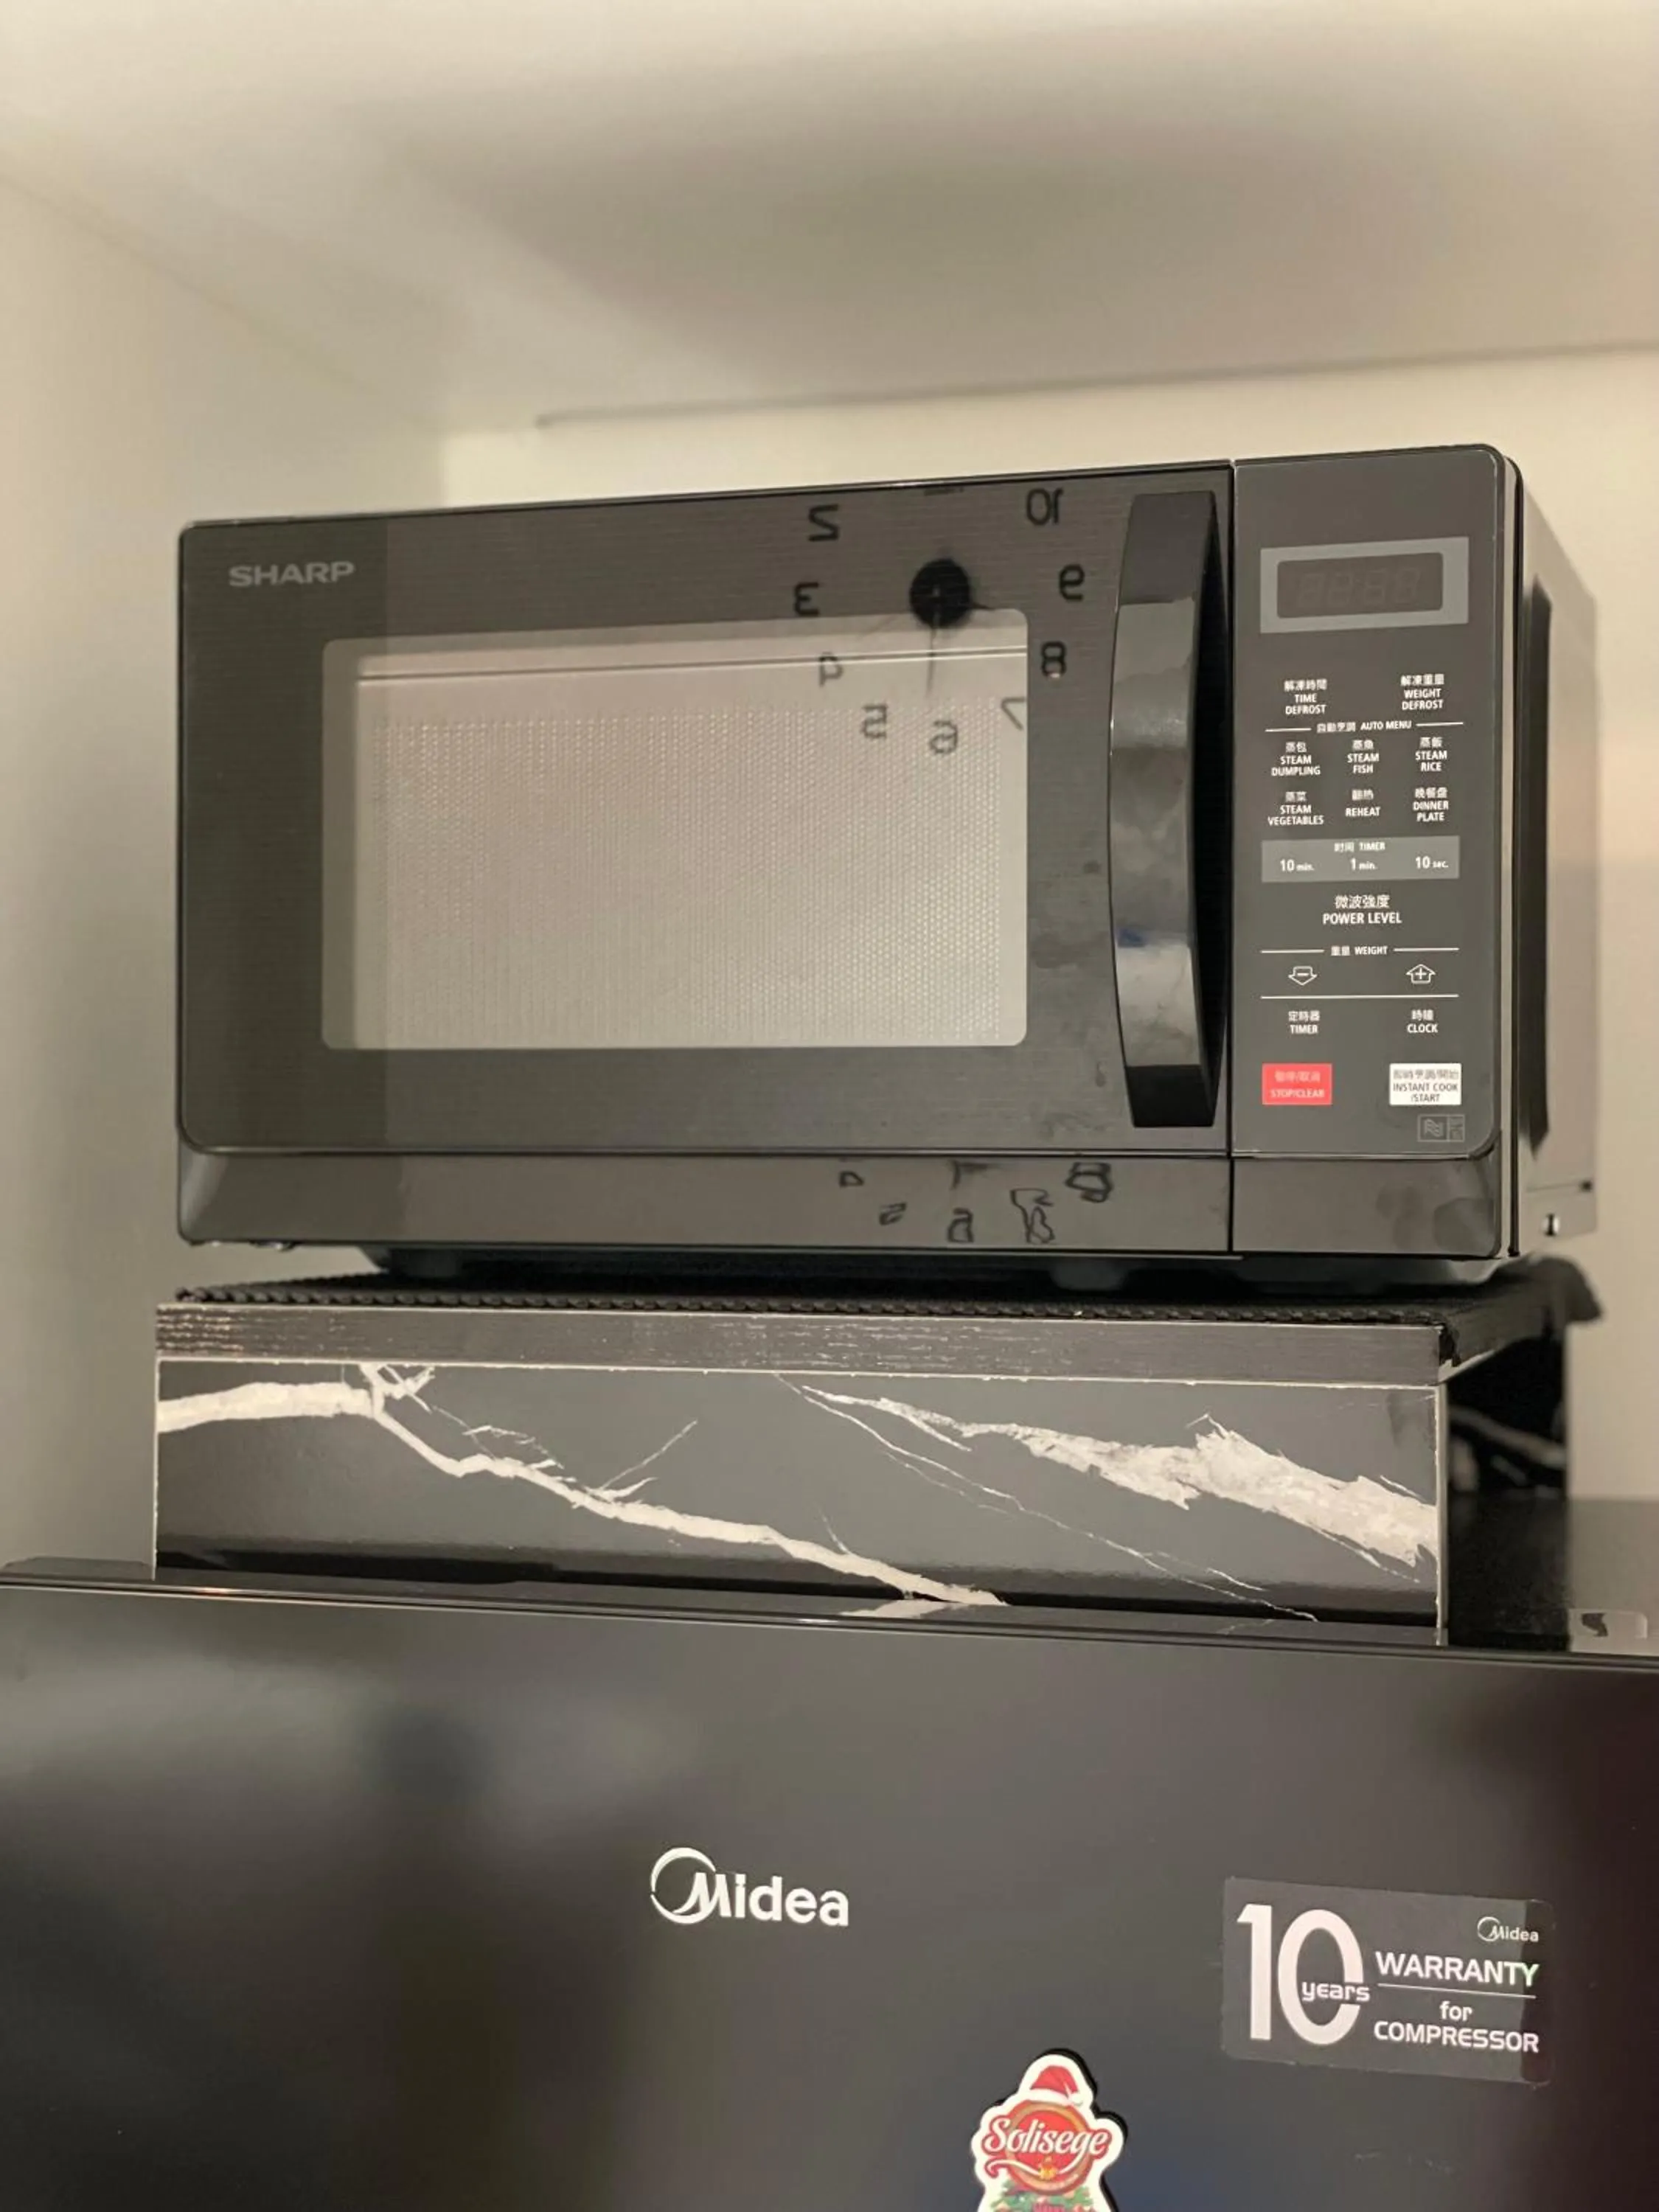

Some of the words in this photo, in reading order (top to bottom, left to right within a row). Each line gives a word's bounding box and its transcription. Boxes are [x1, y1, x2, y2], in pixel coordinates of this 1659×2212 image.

[229, 560, 355, 587] SHARP
[1295, 693, 1318, 703] TIME
[1403, 688, 1441, 698] WEIGHT
[1285, 705, 1326, 714] DEFROST
[1402, 700, 1444, 710] DEFROST
[1360, 721, 1384, 731] AUTO
[1385, 720, 1412, 729] MENU
[1280, 755, 1312, 765] STEAM
[1347, 753, 1380, 763] STEAM
[1415, 751, 1447, 761] STEAM
[1271, 765, 1321, 776] DUMPLING
[1353, 764, 1374, 773] FISH
[1421, 762, 1442, 772] RICE
[1280, 804, 1312, 815] STEAM
[1413, 800, 1449, 810] DINNER
[1345, 807, 1380, 817] REHEAT
[1416, 812, 1445, 822] PLATE
[1267, 815, 1324, 826] VEGETABLES
[1359, 841, 1385, 851] TIMER
[1280, 859, 1295, 872] 10
[1350, 858, 1357, 871] 1
[1415, 856, 1430, 869] 10
[1323, 913, 1364, 925] POWER
[1368, 912, 1402, 924] LEVEL
[1354, 946, 1388, 956] WEIGHT
[1290, 1024, 1318, 1034] TIMER
[1408, 1023, 1438, 1034] CLOCK
[1393, 1082, 1430, 1092] INSTANT
[1433, 1082, 1458, 1092] COOK
[650, 1847, 849, 1926] Midea
[1477, 1916, 1540, 1942] Midea
[1237, 1904, 1364, 2045] 10
[1375, 1951, 1540, 1987] WARRANTY
[1301, 1981, 1370, 2003] years
[1439, 2000, 1473, 2022] for
[1374, 2020, 1540, 2053] COMPRESSOR
